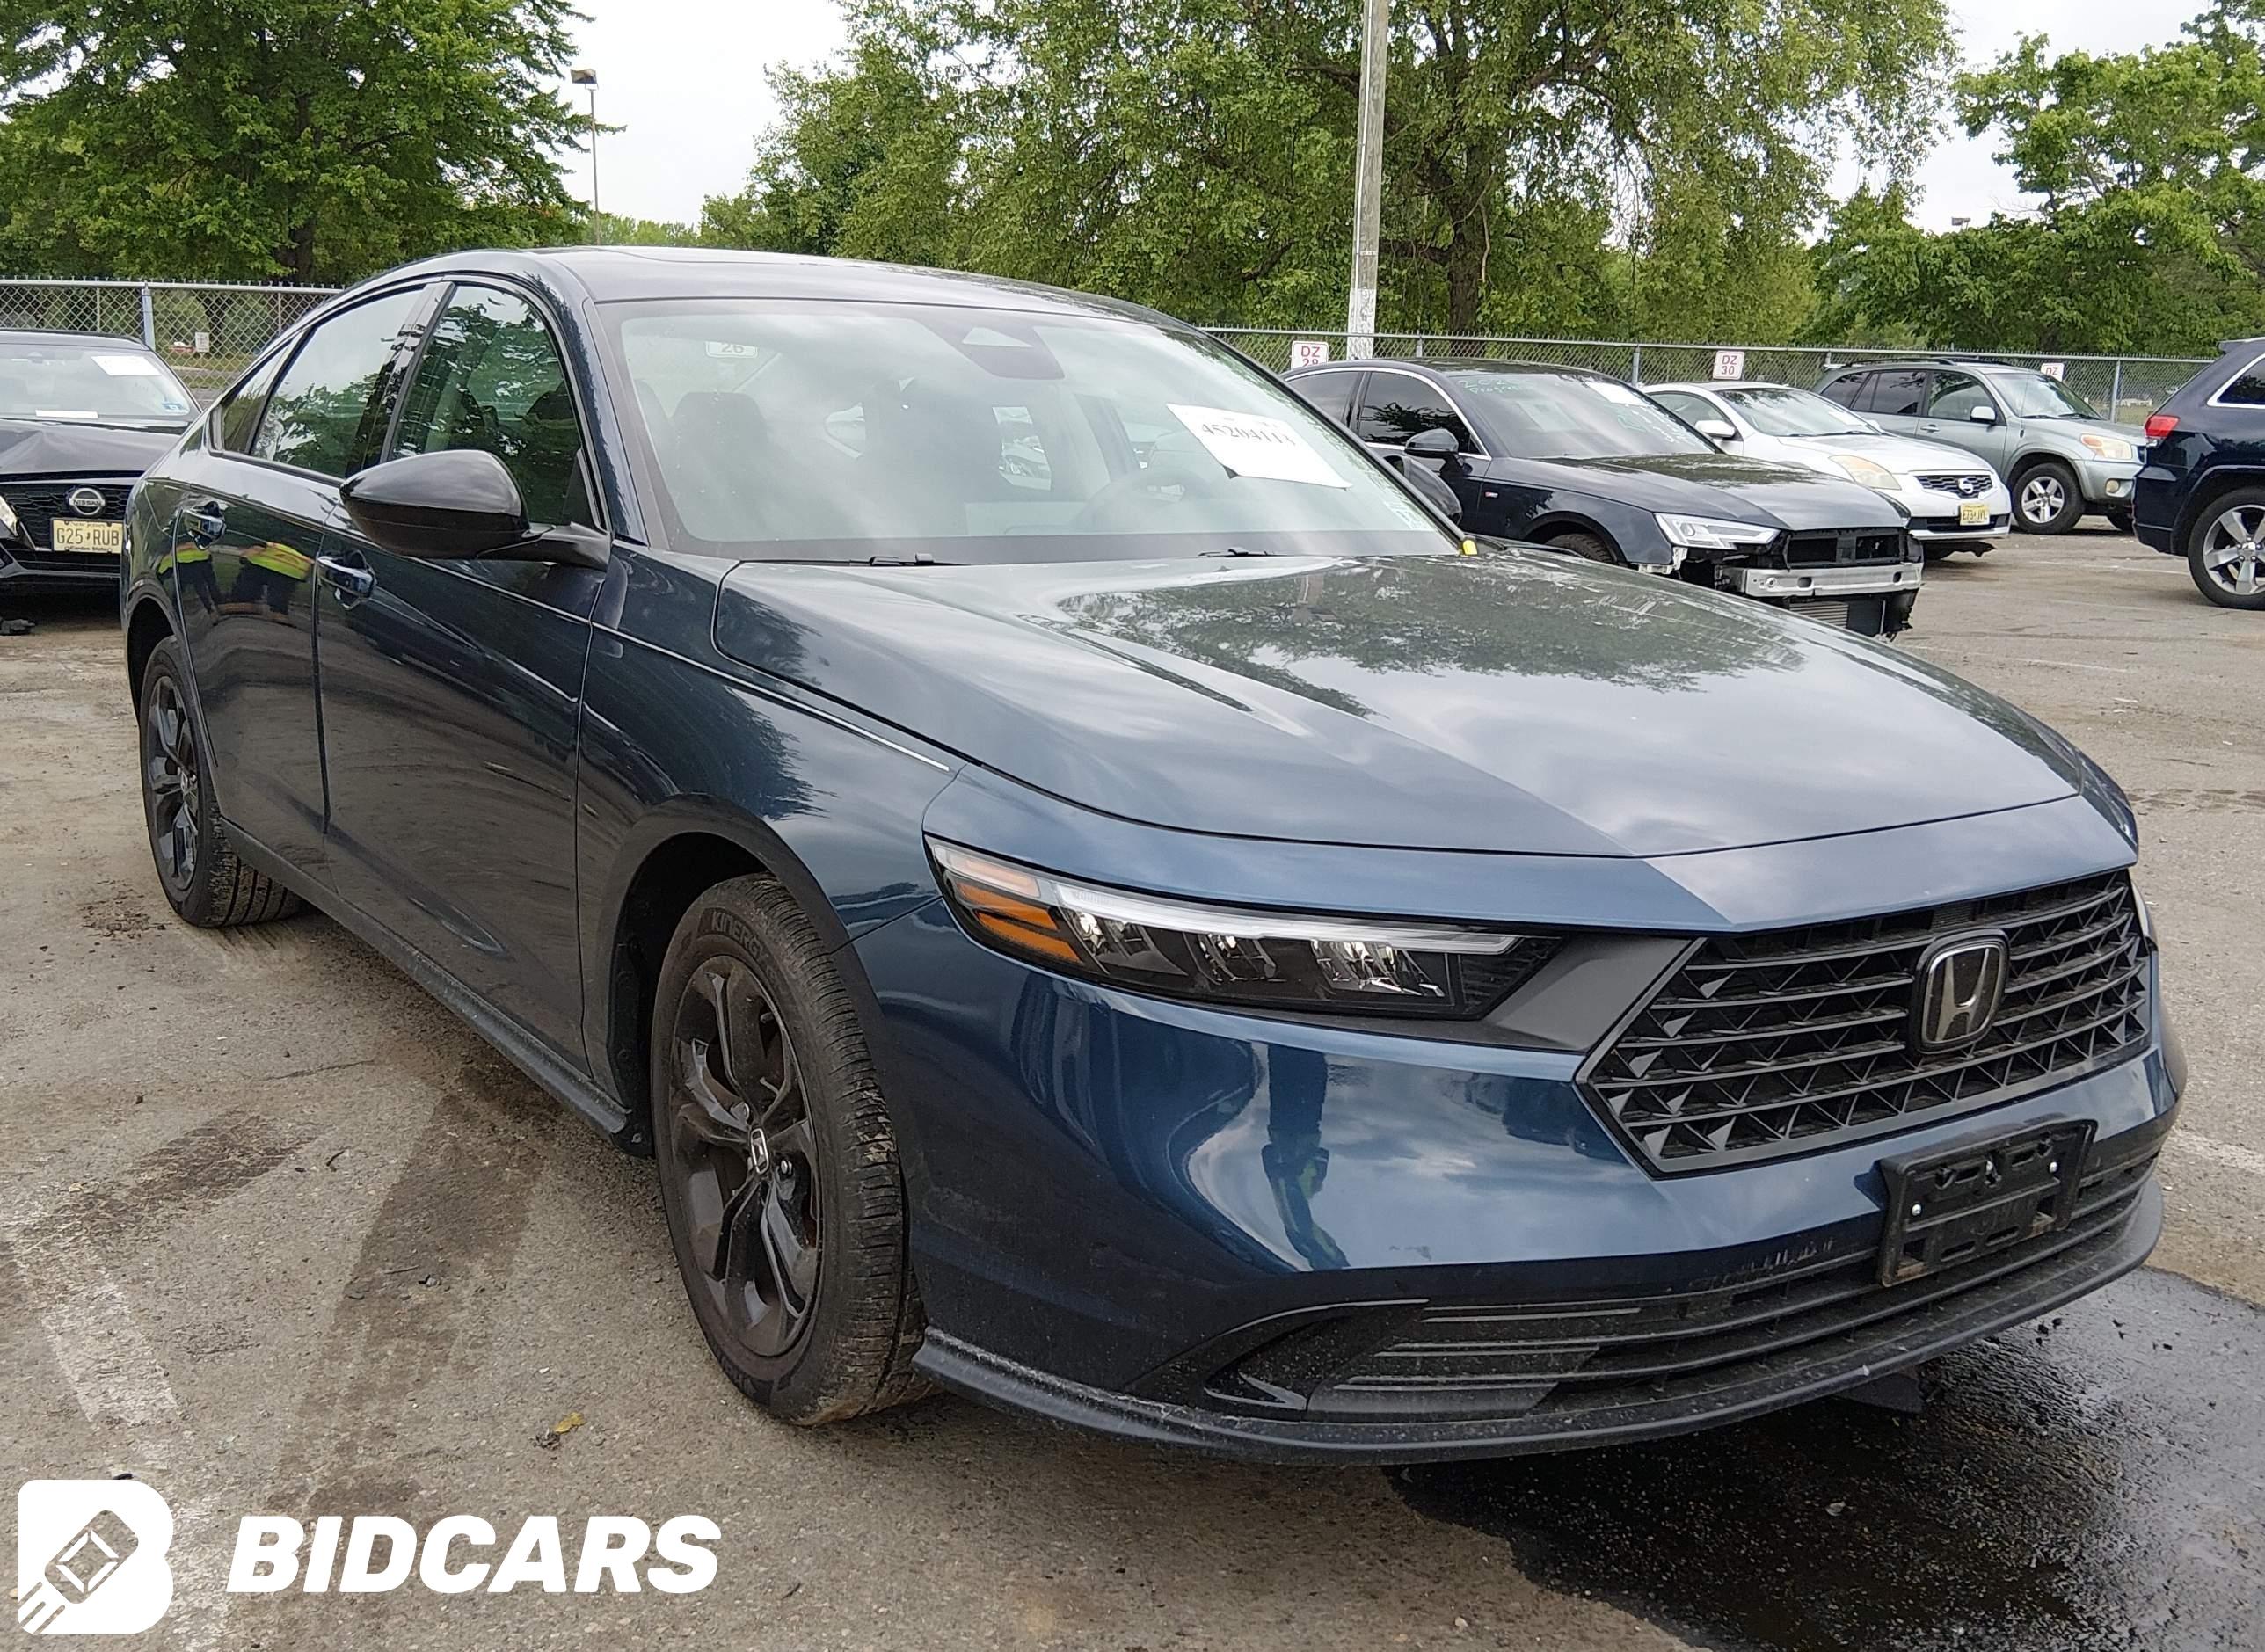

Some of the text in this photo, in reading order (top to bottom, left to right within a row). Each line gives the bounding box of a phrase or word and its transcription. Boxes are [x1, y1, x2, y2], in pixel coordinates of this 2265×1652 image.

[1301, 346, 1321, 357] DZ
[1722, 355, 1738, 366] DZ
[1721, 366, 1735, 375] 30
[56, 528, 120, 546] G25 RUB
[710, 910, 764, 959] KINERGY
